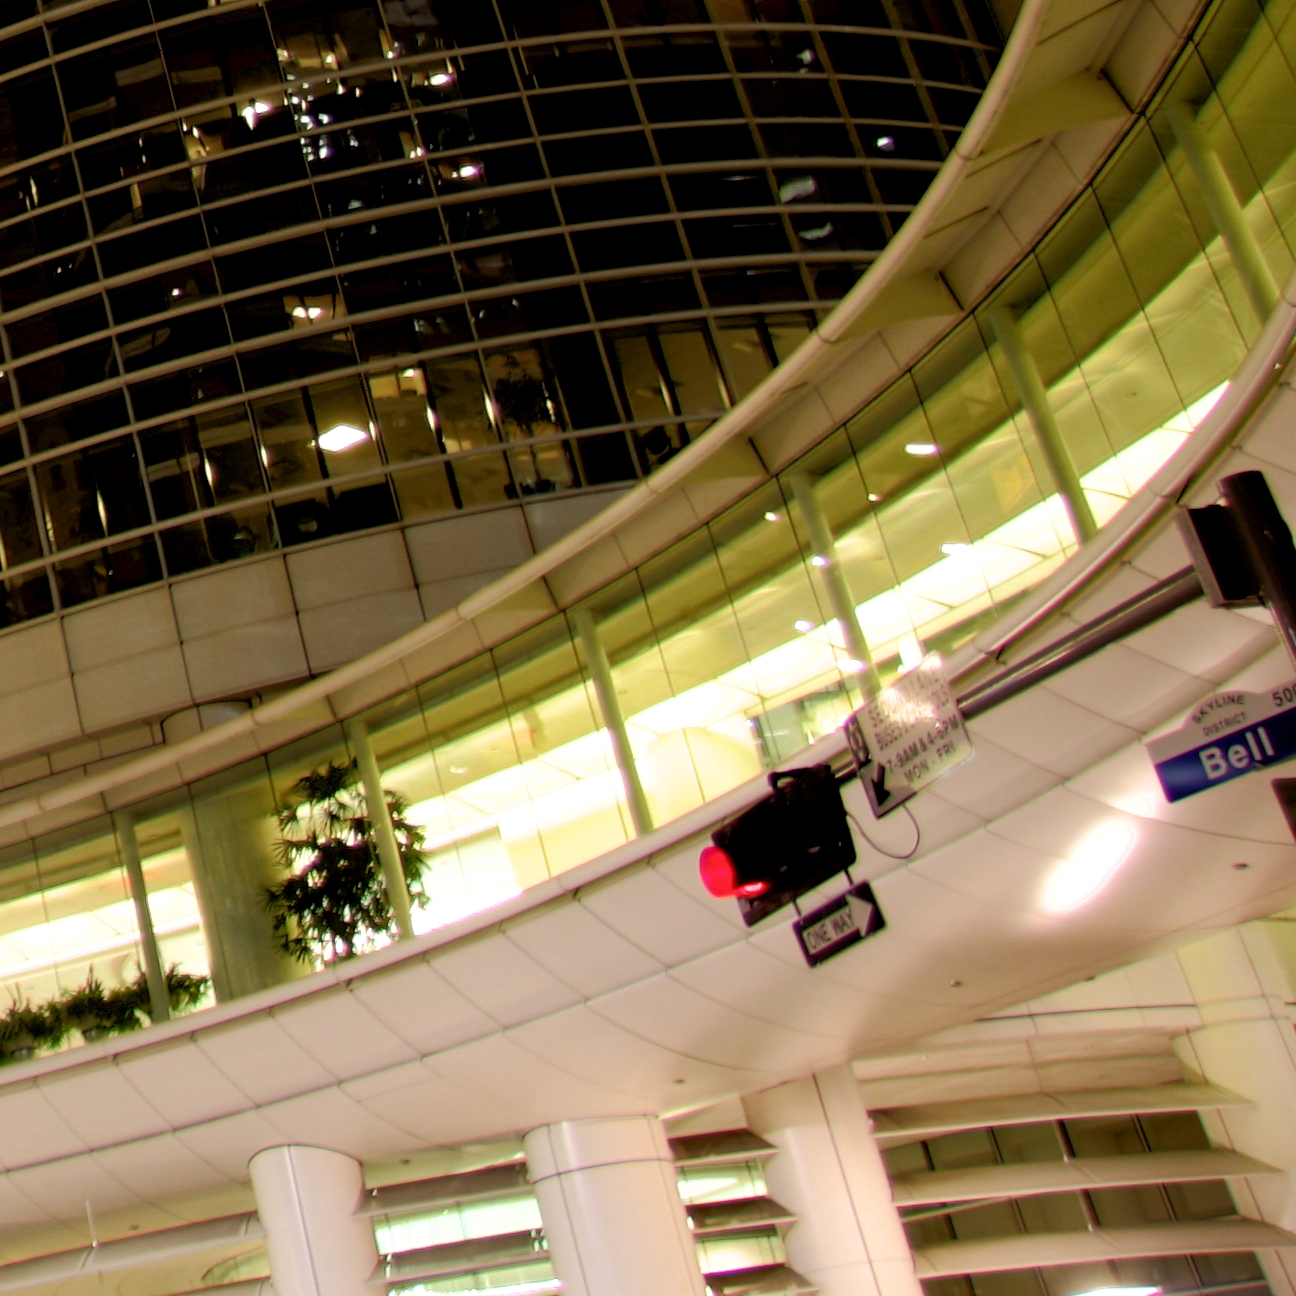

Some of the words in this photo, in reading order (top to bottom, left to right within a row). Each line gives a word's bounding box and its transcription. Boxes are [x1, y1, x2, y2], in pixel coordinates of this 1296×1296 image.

[1191, 693, 1245, 724] SKYLINE
[1203, 711, 1247, 737] DISTRICT
[903, 757, 929, 785] MON
[935, 738, 956, 762] FRI
[1198, 725, 1275, 781] Bell
[806, 922, 831, 950] ONE
[829, 907, 855, 935] WAY
